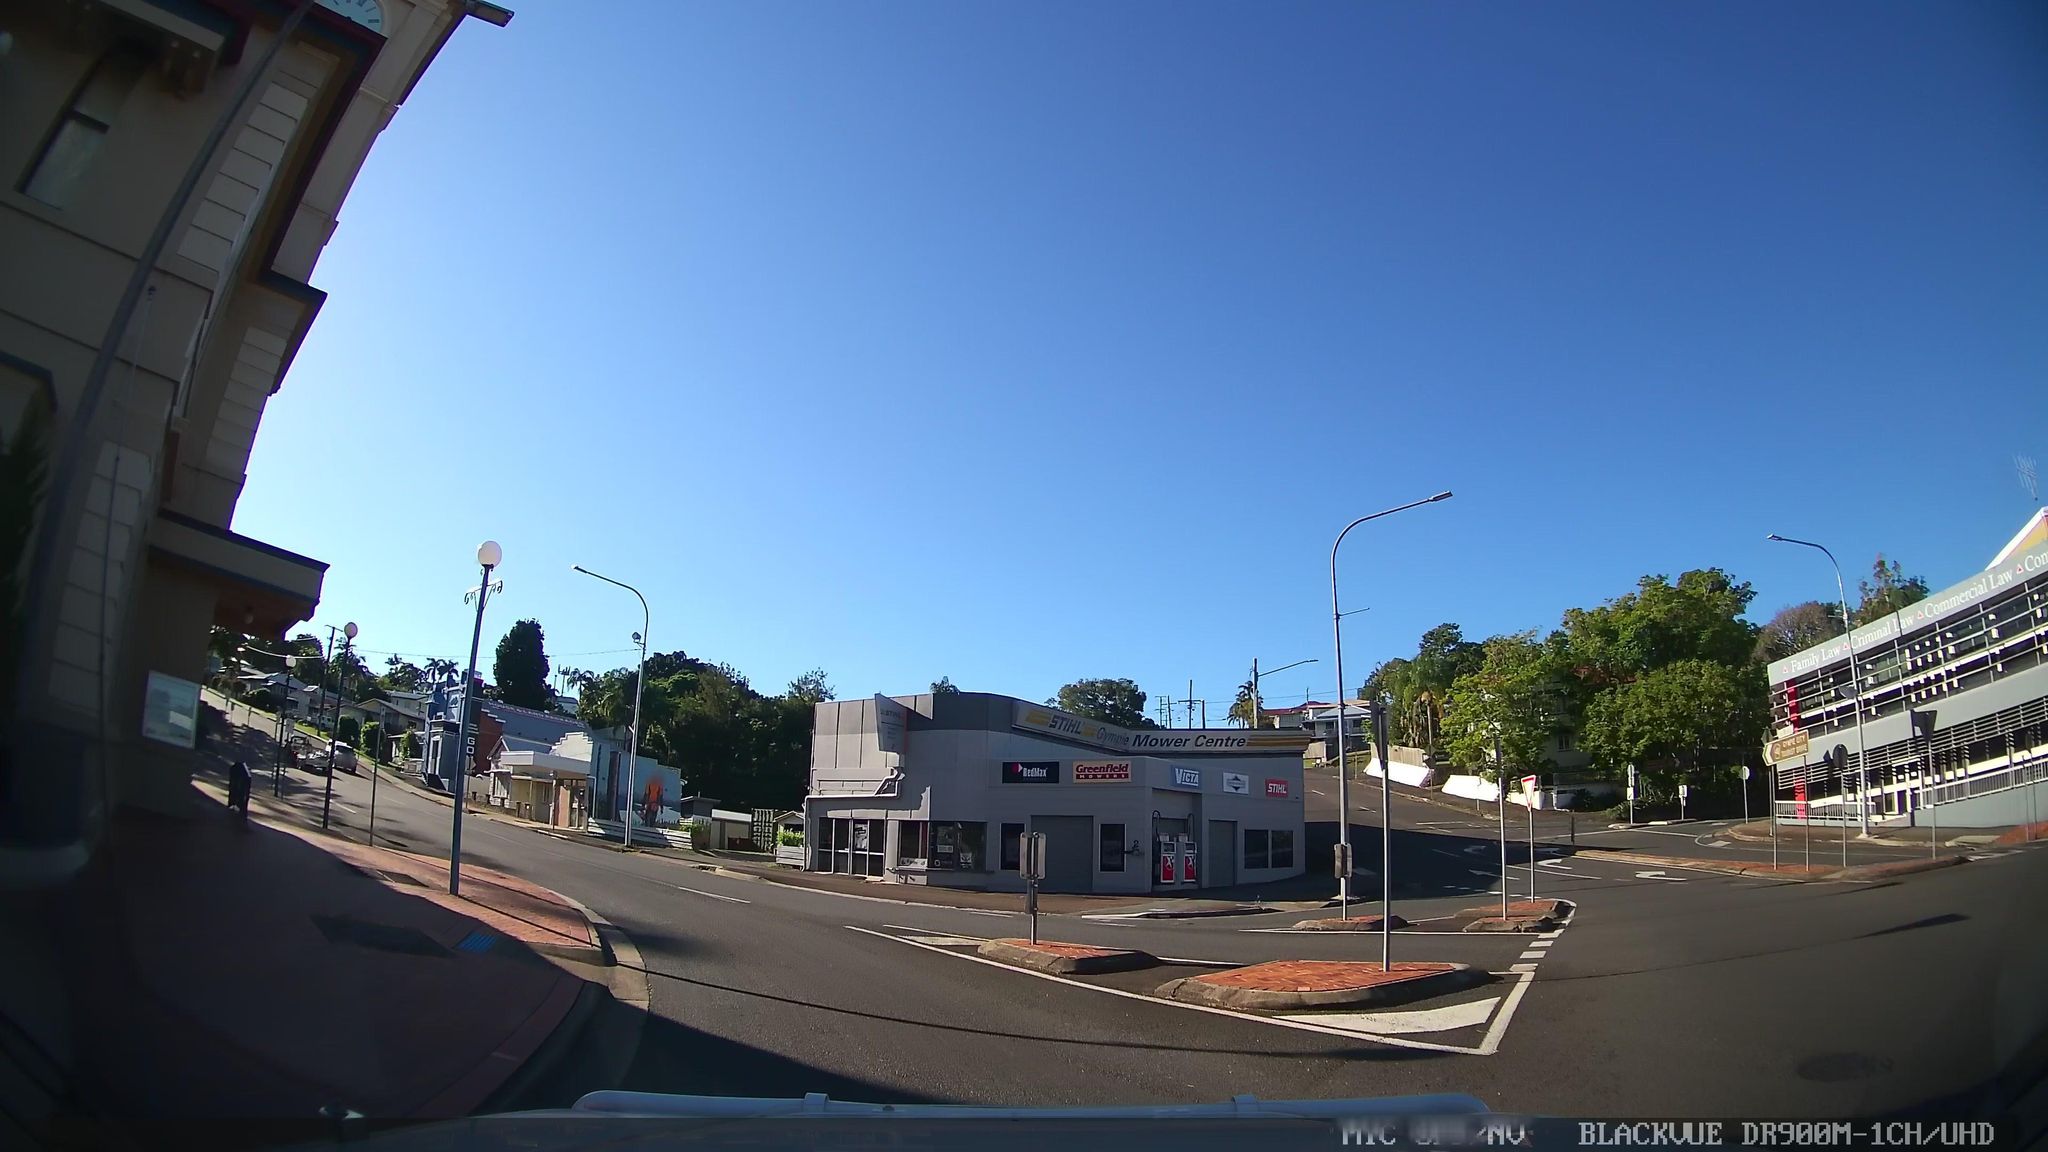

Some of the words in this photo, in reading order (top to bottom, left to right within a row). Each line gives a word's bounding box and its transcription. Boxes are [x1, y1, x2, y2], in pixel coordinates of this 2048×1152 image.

[1791, 653, 1819, 673] Family
[1821, 645, 1841, 660] Law
[1851, 621, 1892, 649] Criminal
[1892, 616, 1914, 633] Law
[1925, 578, 1988, 618] Commercial
[1988, 569, 2013, 590] Law
[1048, 713, 1083, 735] STIHL
[1131, 734, 1191, 748] Mower
[1194, 734, 1246, 748] Centre
[1076, 763, 1129, 774] Greenfield
[1267, 783, 1287, 794] STIHL
